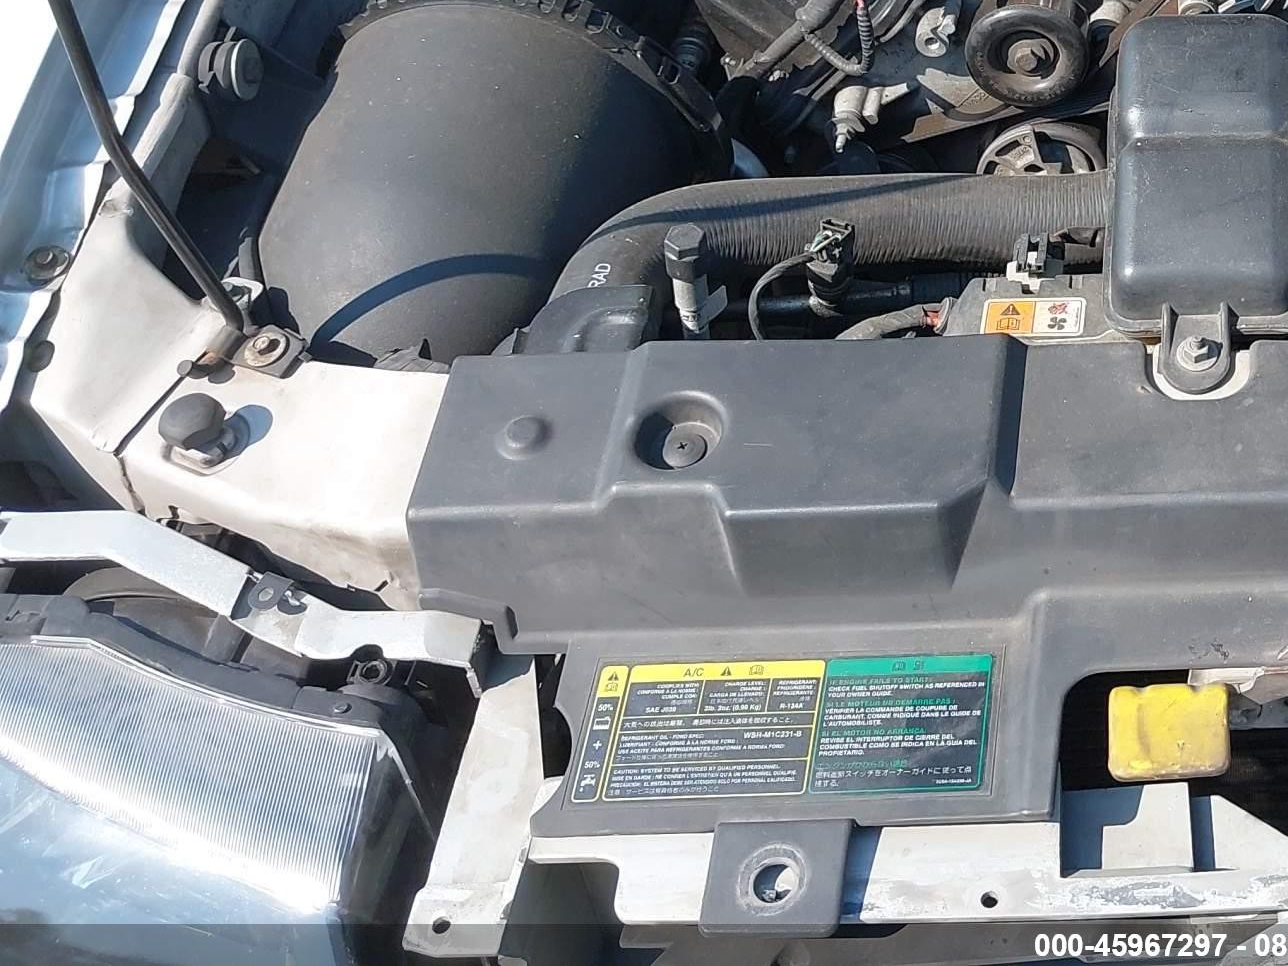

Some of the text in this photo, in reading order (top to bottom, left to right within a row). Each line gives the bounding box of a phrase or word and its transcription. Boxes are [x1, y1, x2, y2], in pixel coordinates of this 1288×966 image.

[684, 667, 705, 678] A/C
[934, 681, 977, 689] REFERENCED
[598, 703, 614, 712] 50%
[749, 703, 762, 712] Kg)
[780, 702, 803, 710] R-134A
[818, 749, 865, 757] PROPIETARIO.
[584, 761, 601, 769] 50%
